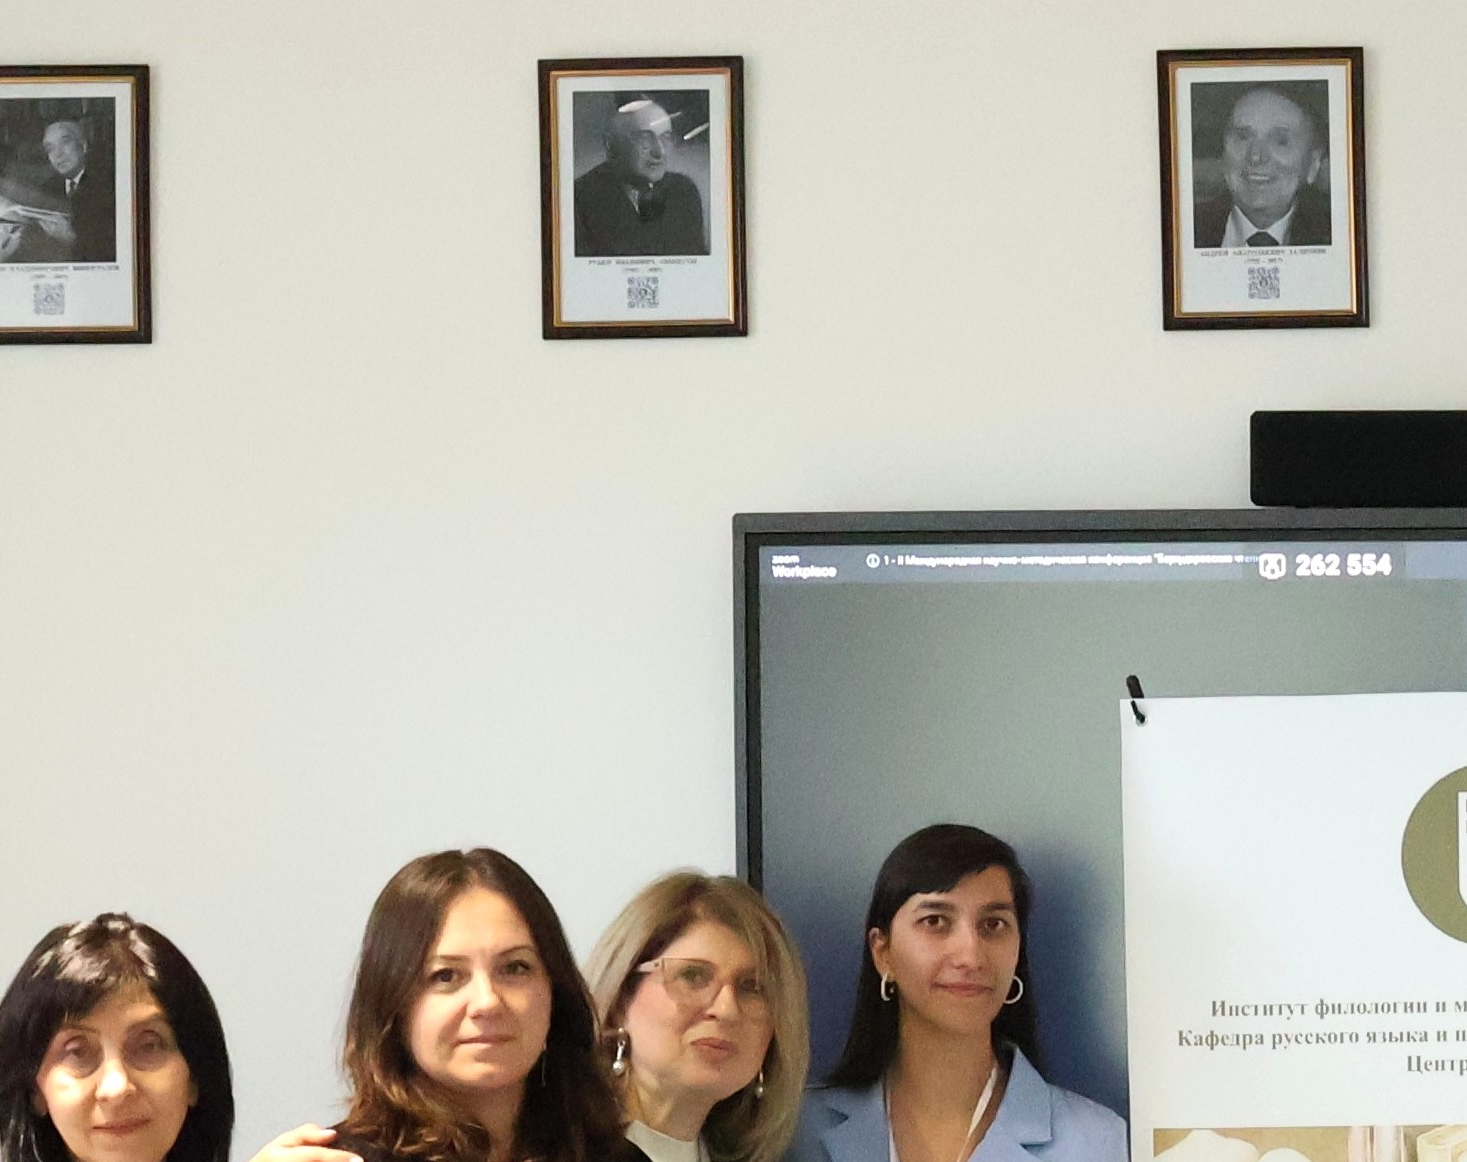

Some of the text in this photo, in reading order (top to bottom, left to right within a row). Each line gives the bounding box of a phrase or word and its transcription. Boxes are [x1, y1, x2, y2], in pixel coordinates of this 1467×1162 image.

[772, 565, 837, 580] Workplace
[1295, 552, 1393, 577] 262 554
[1210, 999, 1310, 1021] Институт
[1314, 998, 1429, 1020] филологии
[1435, 1000, 1448, 1014] и
[1177, 1029, 1265, 1051] Кафедра
[1271, 1030, 1360, 1050] русского
[1366, 1029, 1429, 1045] языка
[1436, 1028, 1448, 1042] и
